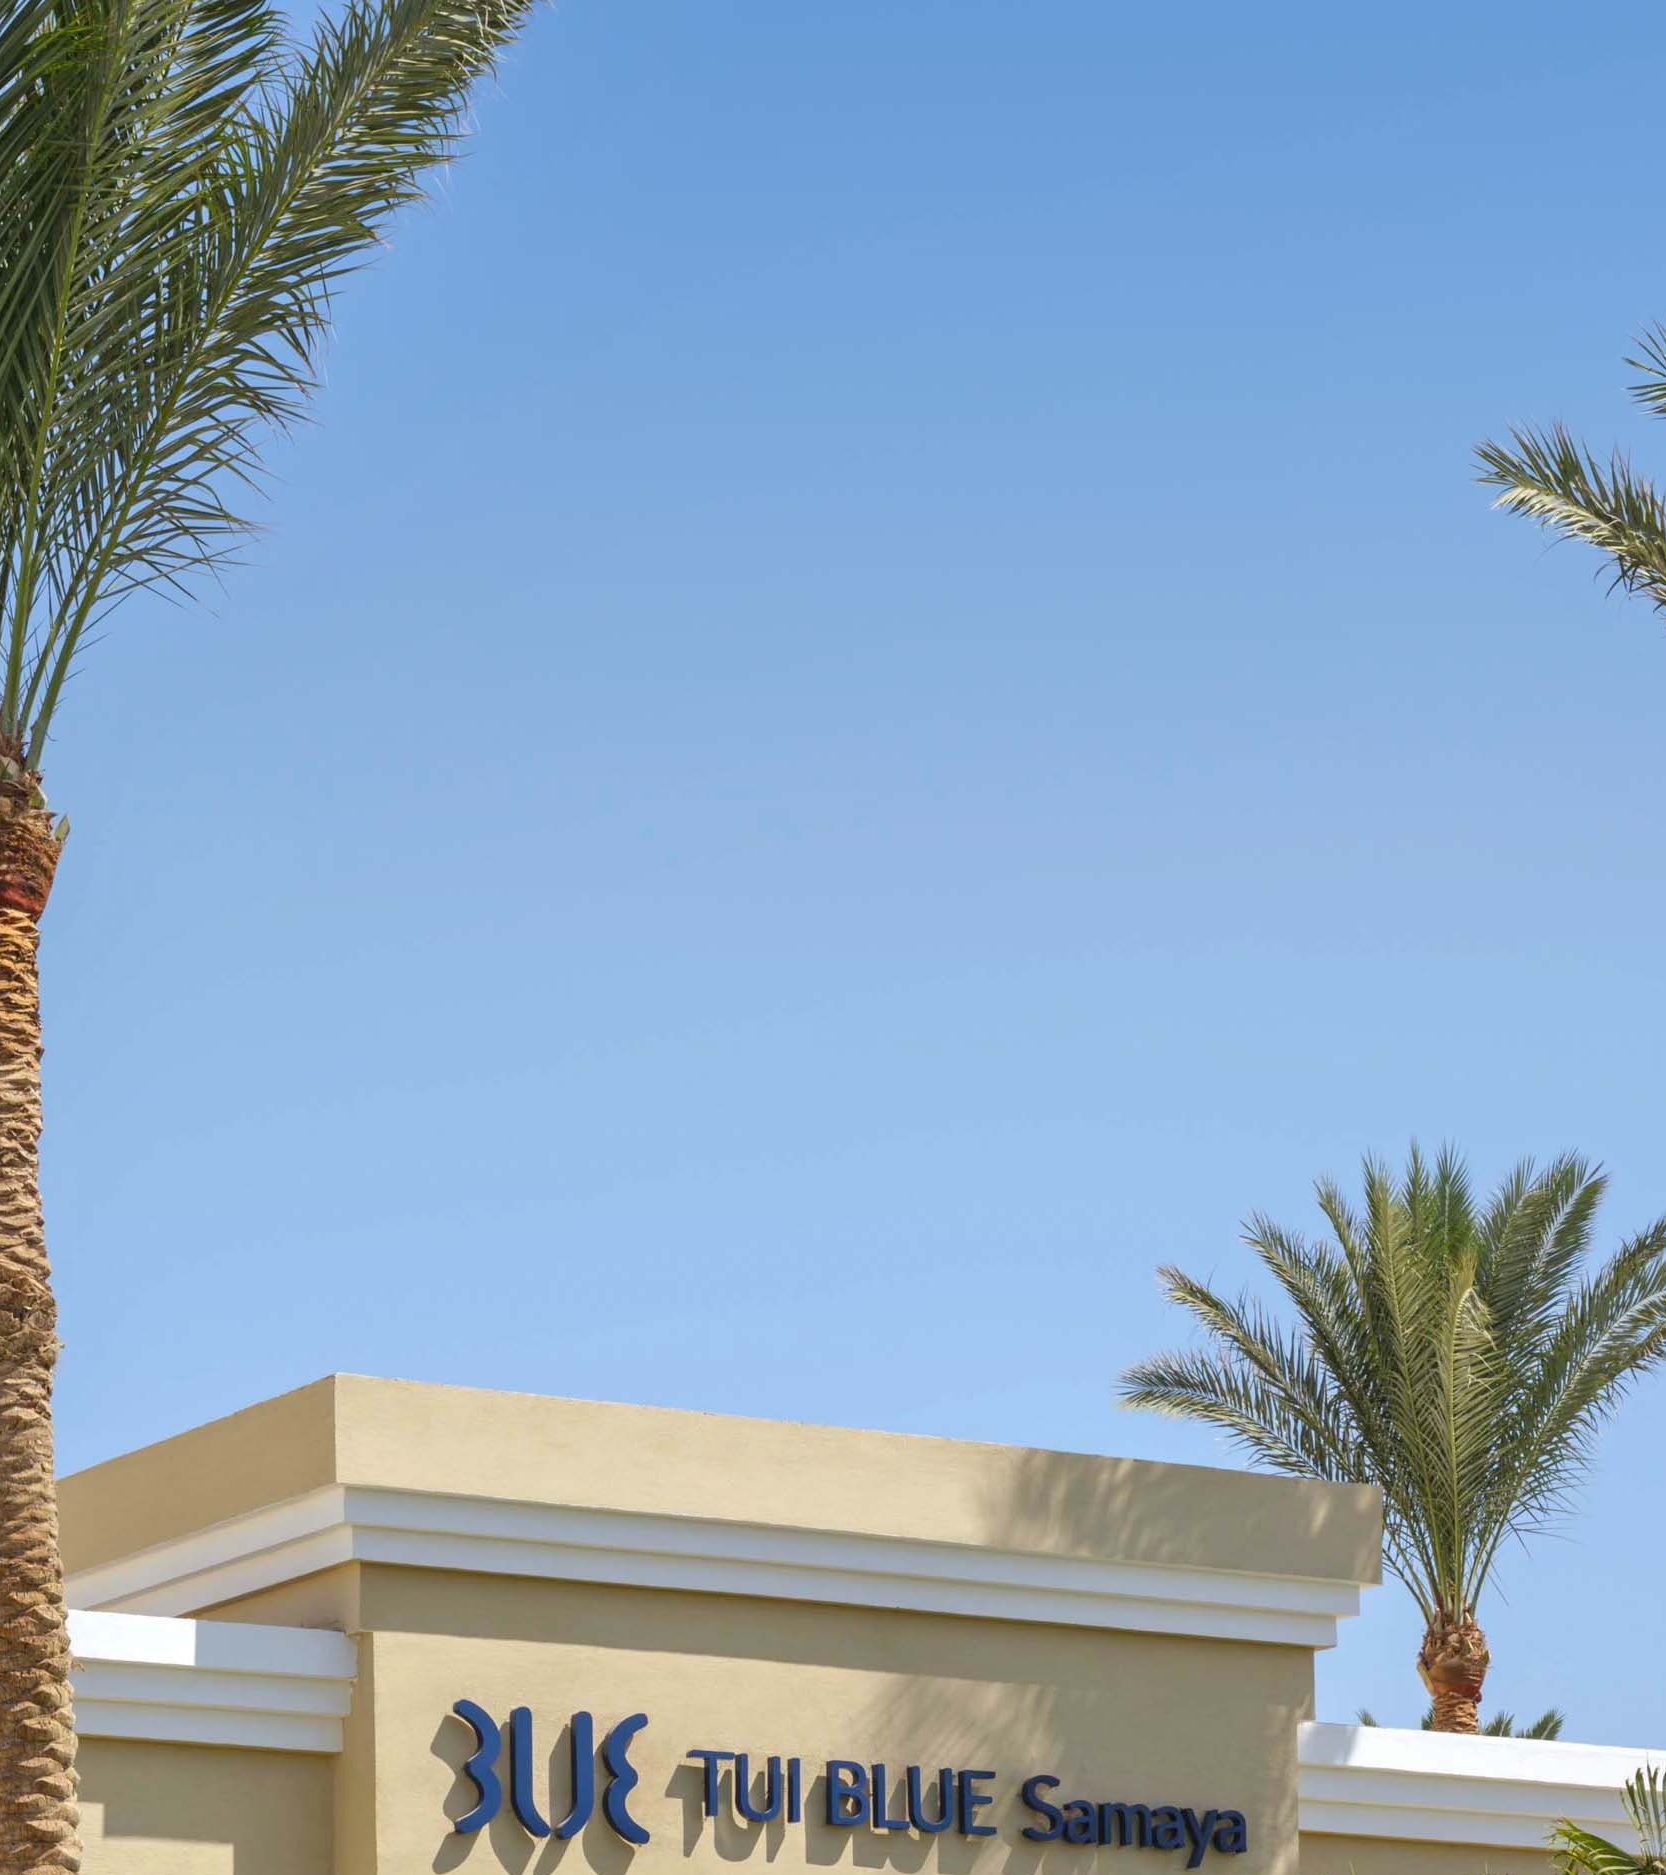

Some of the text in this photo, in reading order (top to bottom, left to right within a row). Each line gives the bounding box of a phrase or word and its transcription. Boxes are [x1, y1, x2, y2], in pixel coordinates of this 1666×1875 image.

[686, 1749, 1247, 1869] TUI BLUE Samaya
